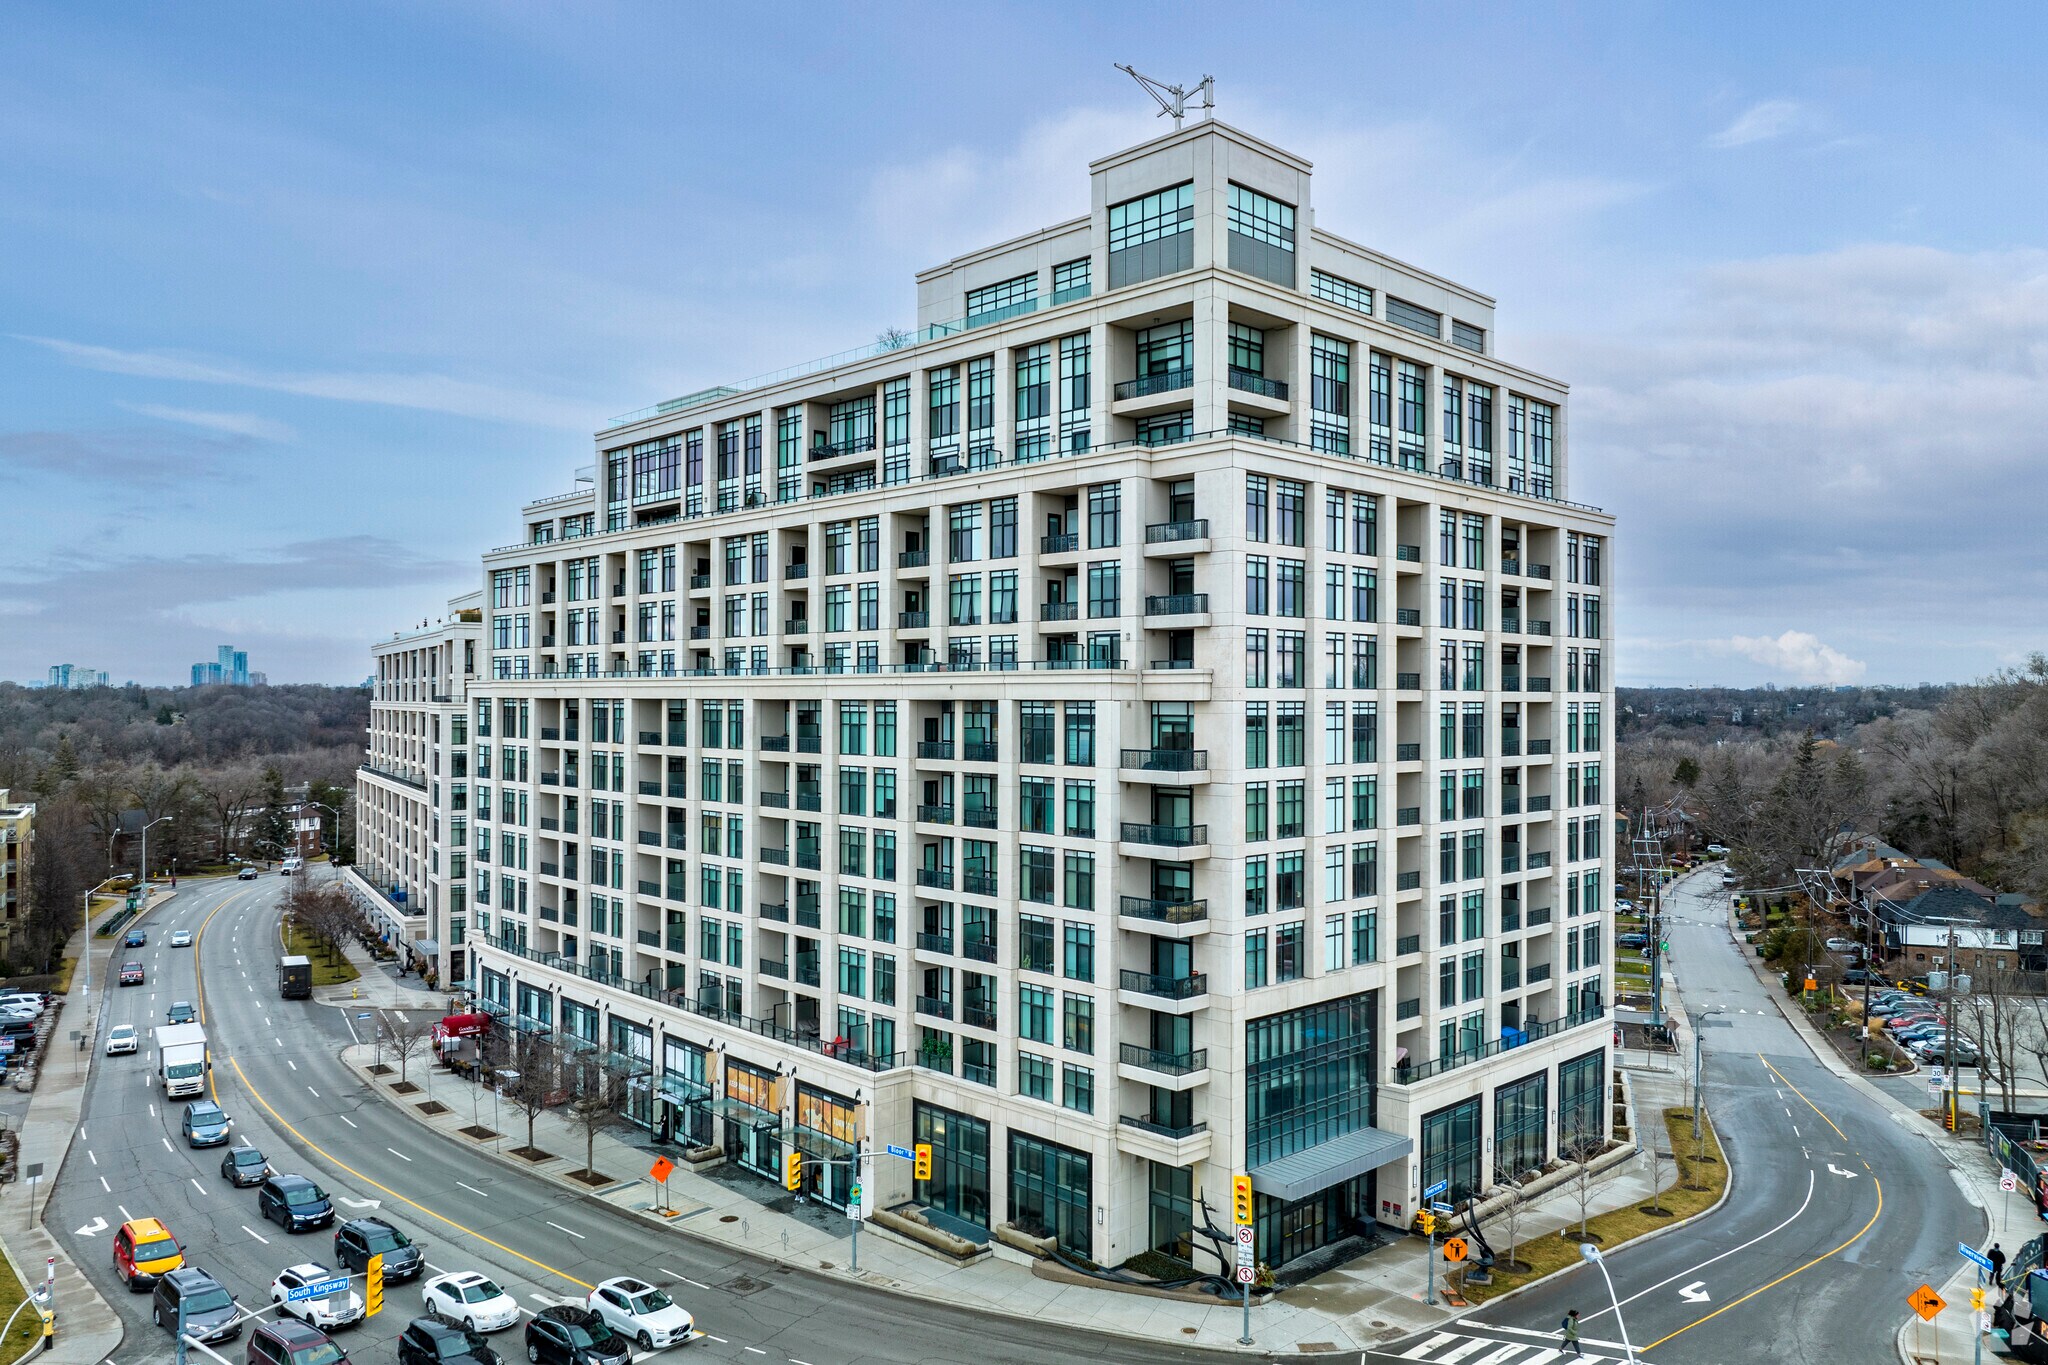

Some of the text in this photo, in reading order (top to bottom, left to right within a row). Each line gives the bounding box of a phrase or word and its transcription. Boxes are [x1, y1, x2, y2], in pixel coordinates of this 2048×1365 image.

[891, 1145, 905, 1155] Bloor
[1961, 1245, 1986, 1264] Riverview
[290, 1280, 347, 1299] South Kingsway
